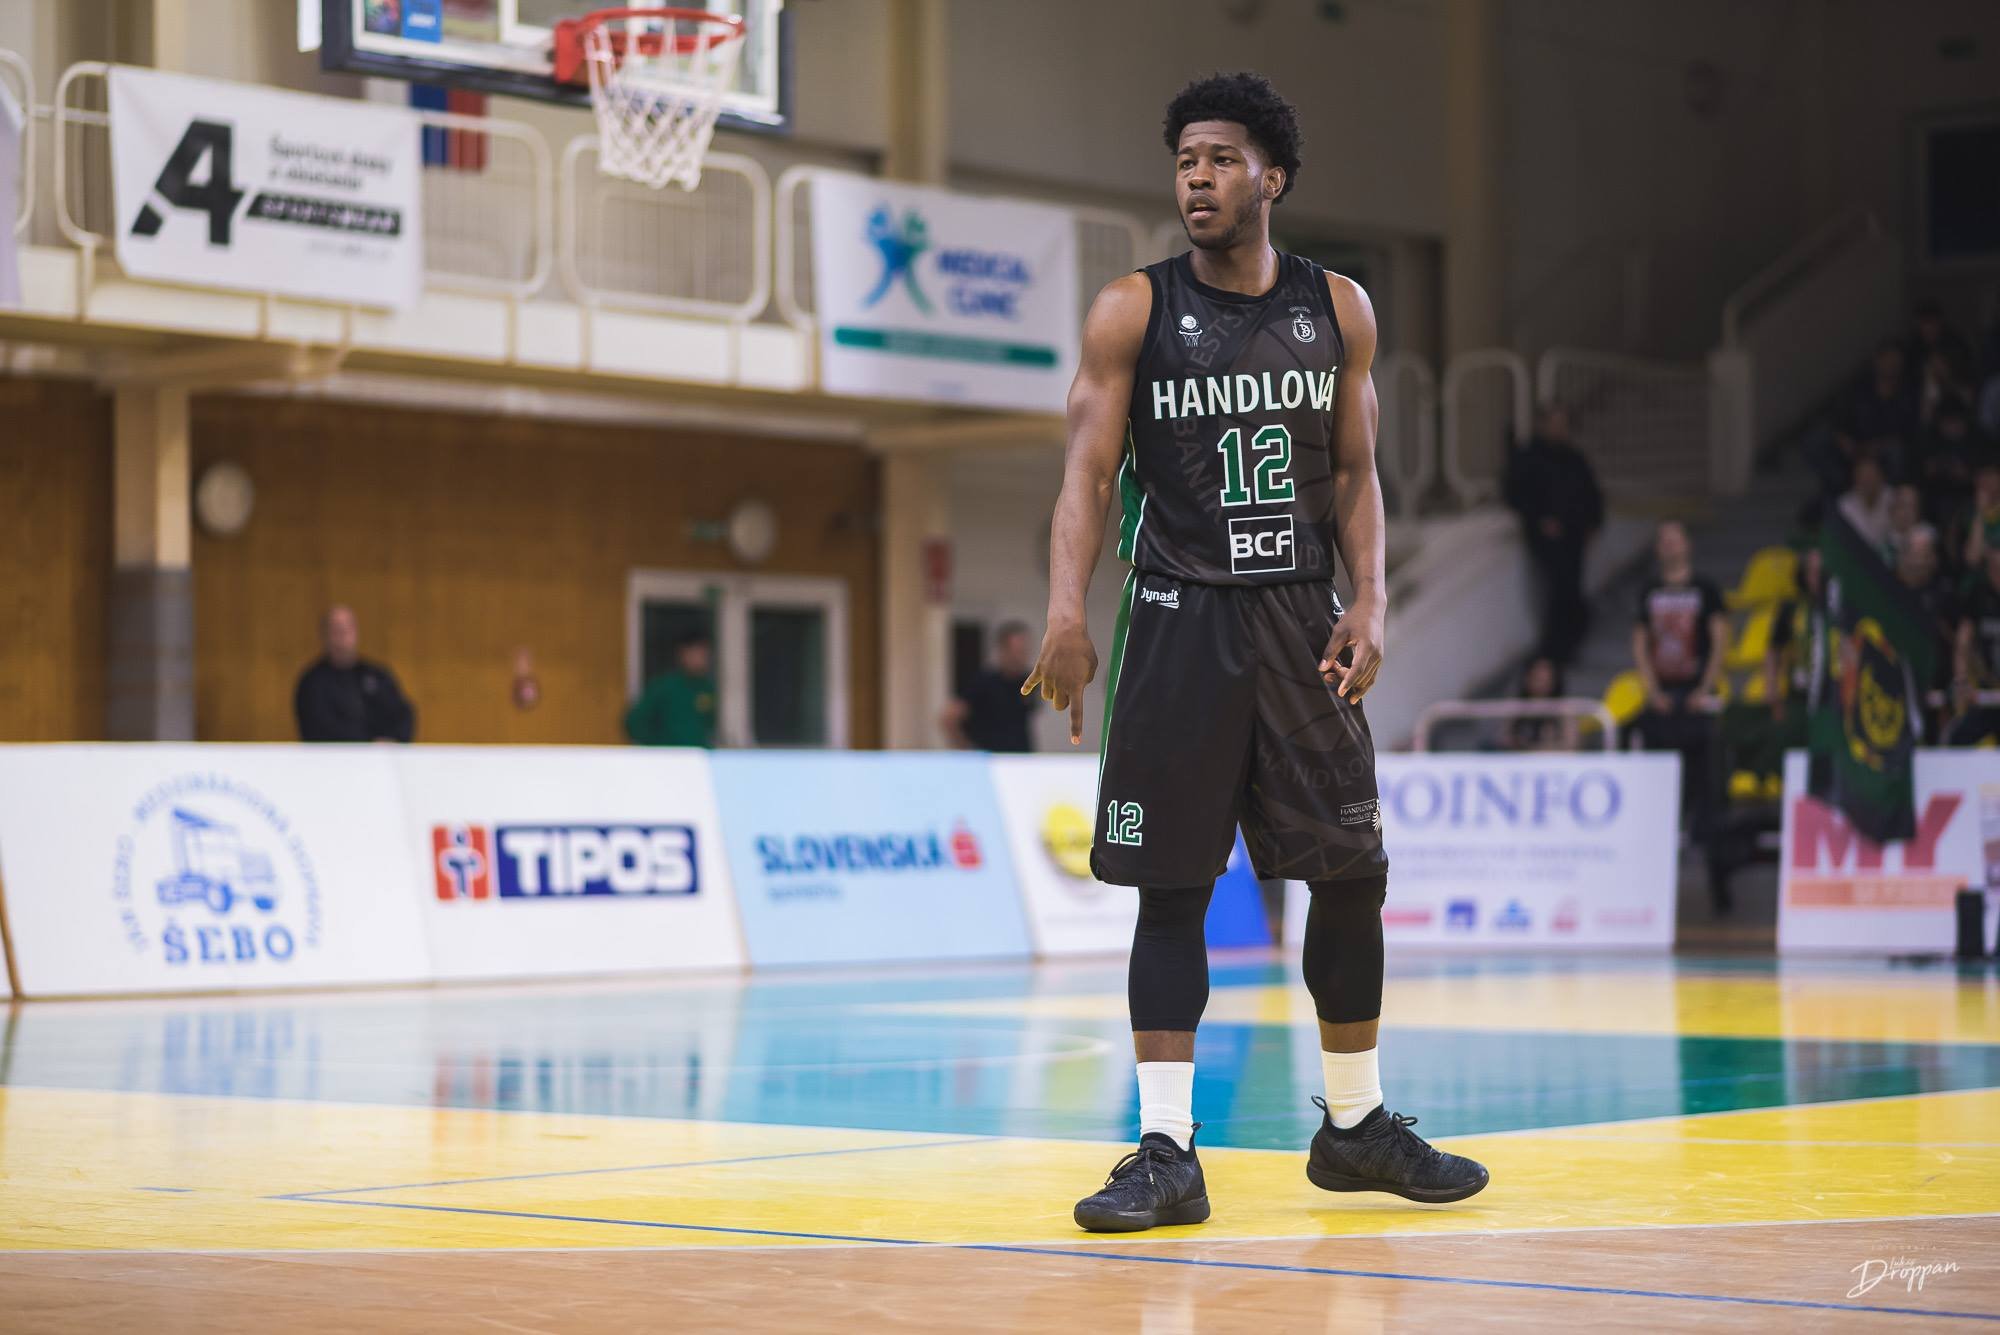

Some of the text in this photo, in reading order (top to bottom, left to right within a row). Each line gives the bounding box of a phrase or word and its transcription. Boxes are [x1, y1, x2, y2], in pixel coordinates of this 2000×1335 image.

[1152, 366, 1338, 420] HANDLOVÁ
[1217, 424, 1295, 507] 12
[1230, 530, 1292, 559] BCF
[1107, 800, 1143, 846] 12
[503, 829, 693, 895] TIPOS
[162, 917, 294, 962] ŠEBO
